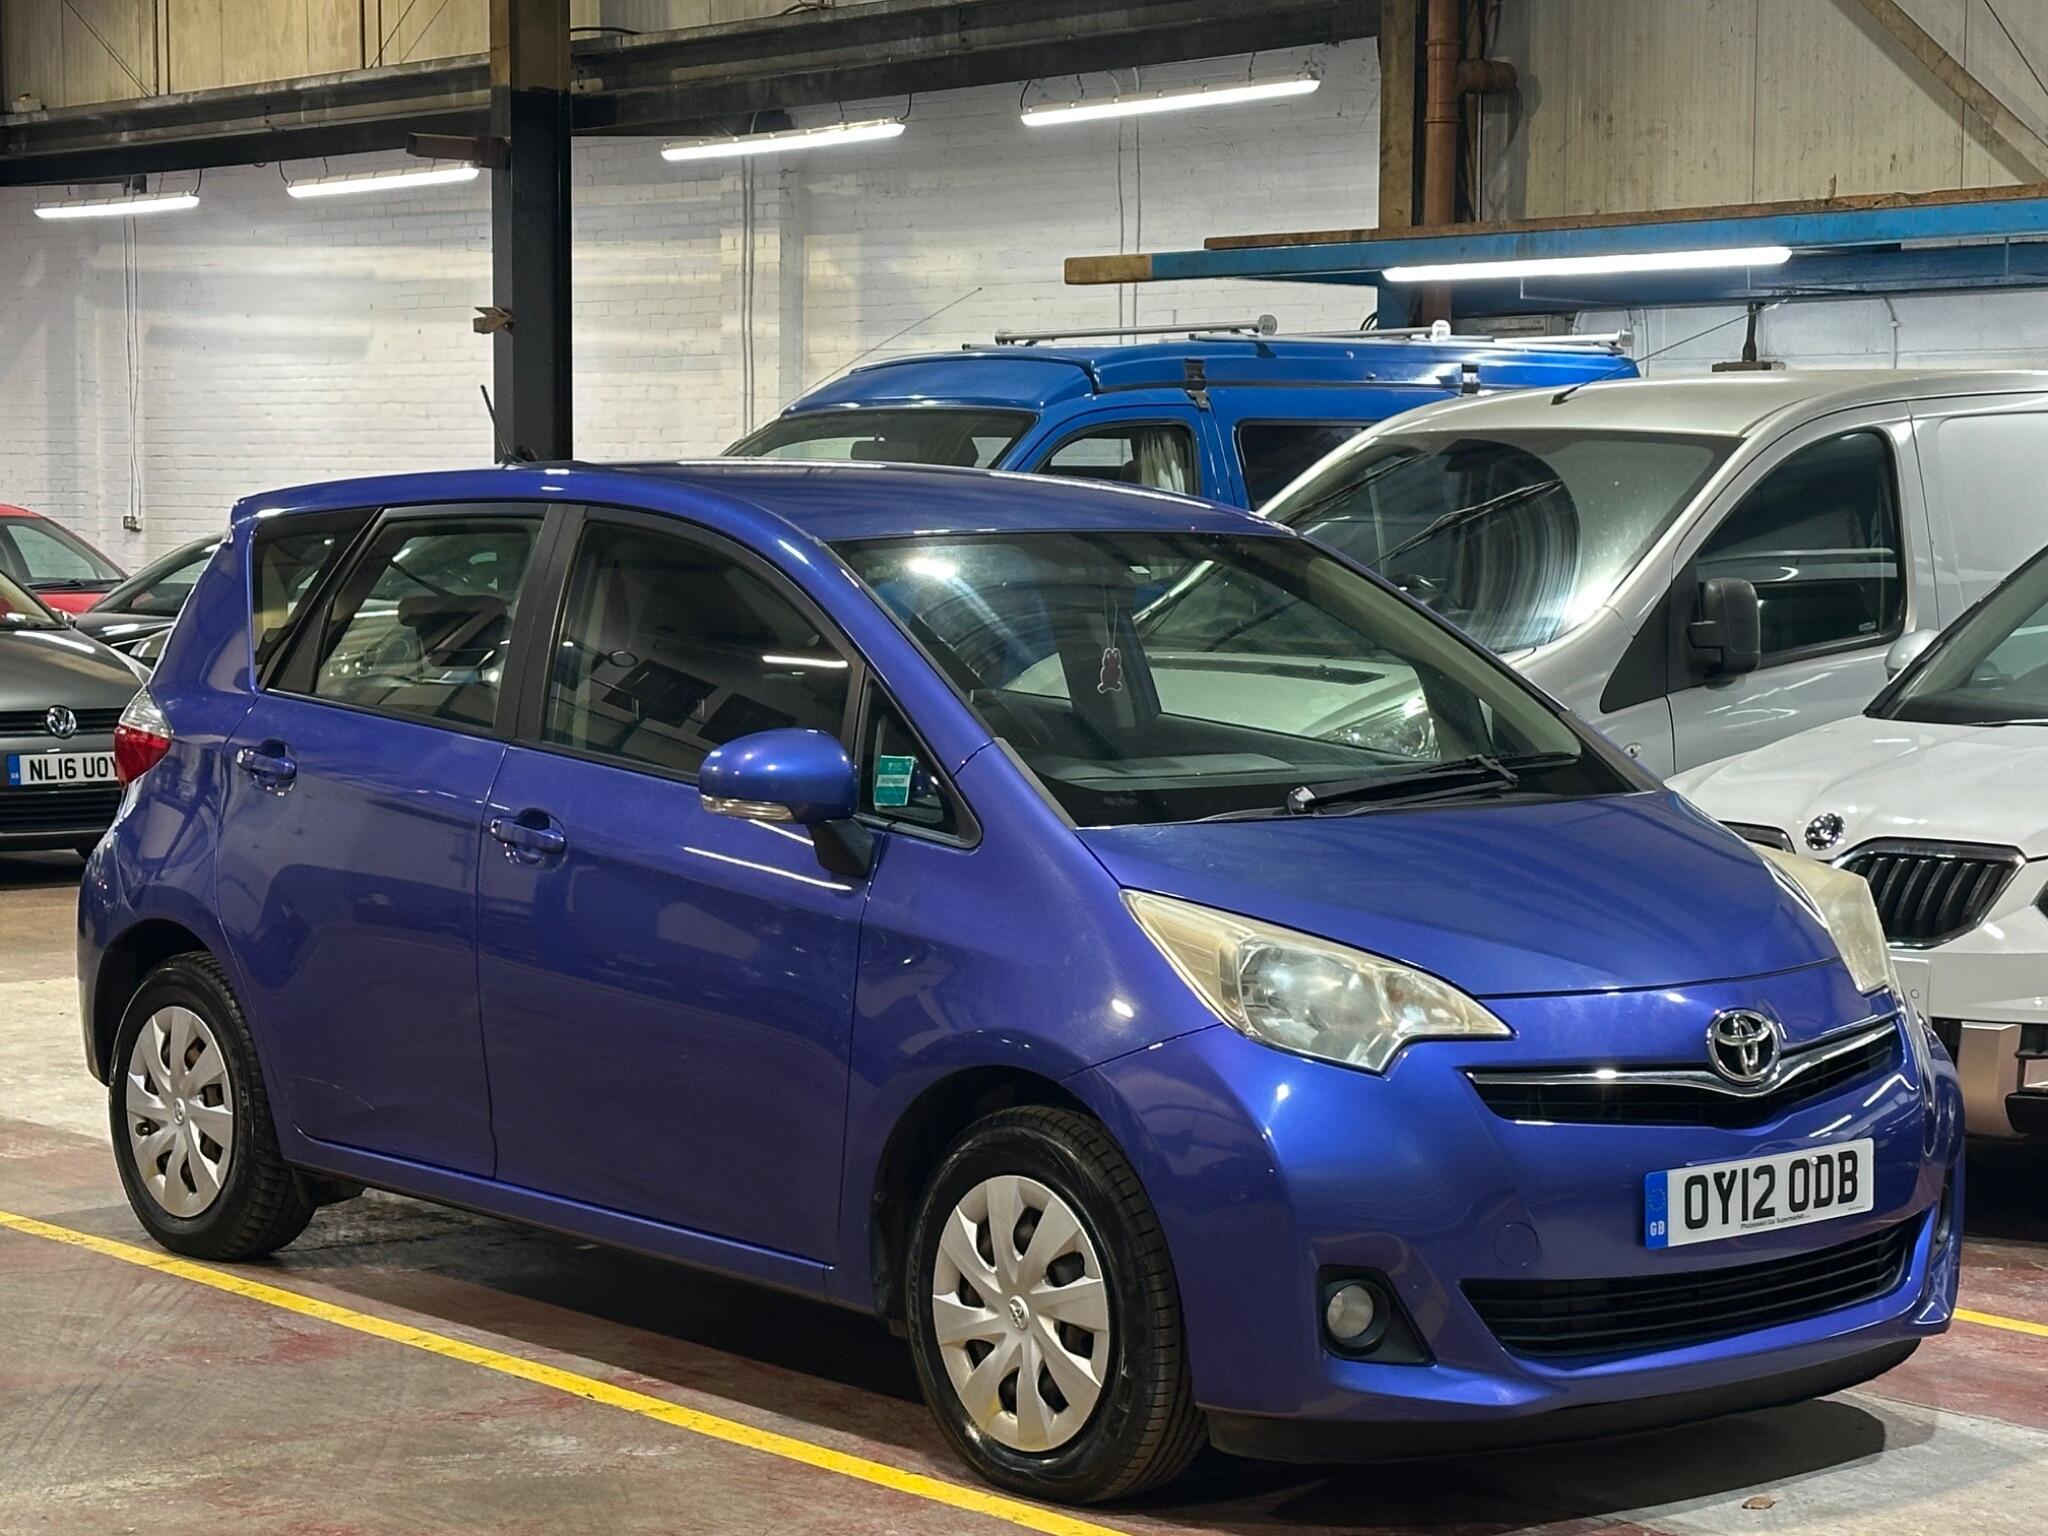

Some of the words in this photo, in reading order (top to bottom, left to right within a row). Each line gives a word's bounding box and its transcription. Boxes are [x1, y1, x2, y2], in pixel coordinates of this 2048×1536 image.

[29, 758, 77, 781] NL16
[1684, 1164, 1776, 1230] OY12
[1788, 1150, 1858, 1213] ODB
[1650, 1220, 1665, 1236] GB
